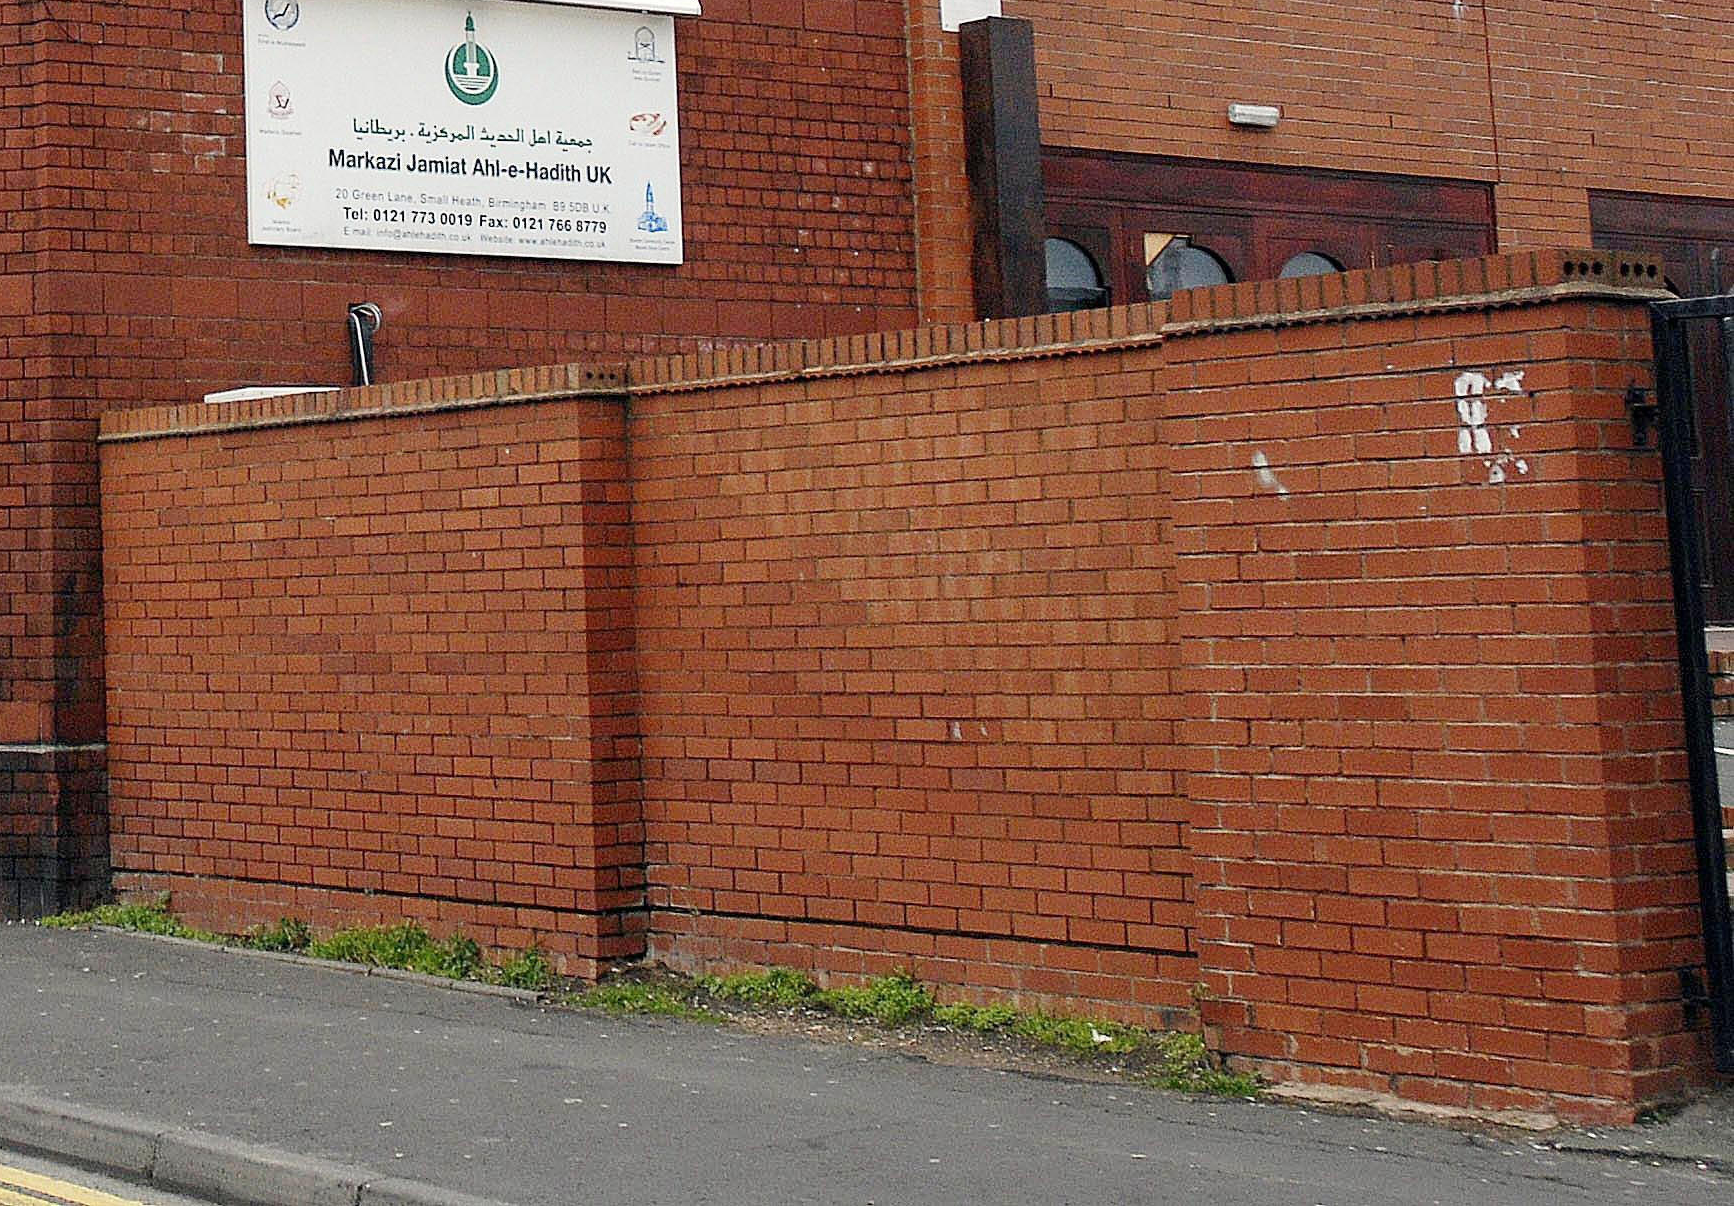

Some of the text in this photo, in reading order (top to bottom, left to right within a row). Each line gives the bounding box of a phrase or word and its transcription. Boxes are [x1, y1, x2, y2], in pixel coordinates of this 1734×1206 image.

[353, 118, 406, 142] بريطانيا
[418, 122, 475, 144] المركزية
[479, 126, 524, 148] الحديث
[328, 149, 613, 184] Markazi Jamiat Ahl-e-Hadith UK
[335, 188, 348, 200] 20
[352, 189, 384, 202] Green
[420, 193, 449, 205] Small
[488, 197, 546, 211] Birmingham
[343, 206, 607, 234] Tel: 0121 773 0019 Fax: 0121 766 8779
